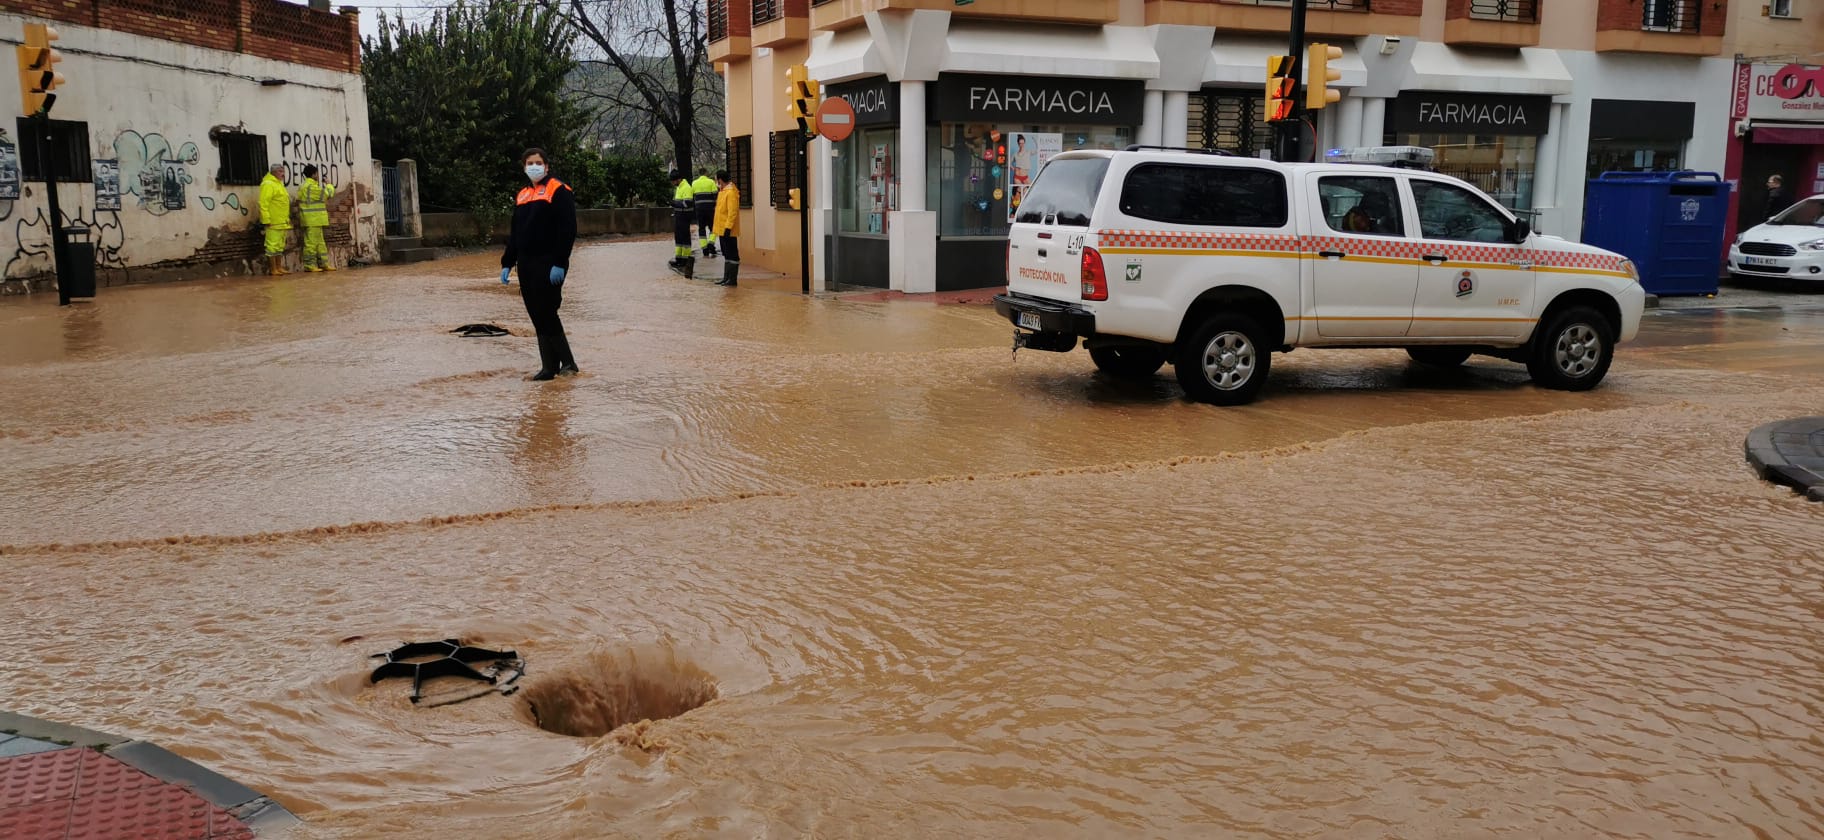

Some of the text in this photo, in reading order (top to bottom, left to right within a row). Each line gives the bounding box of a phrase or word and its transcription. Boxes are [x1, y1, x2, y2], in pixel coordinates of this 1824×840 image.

[970, 87, 1114, 114] FARMACIA
[1737, 67, 1750, 114] GALIANA
[1419, 102, 1527, 125] FARMACIA
[281, 131, 354, 167] PROXIMO
[1019, 266, 1067, 285] PROTECCIÓN CIVIL
